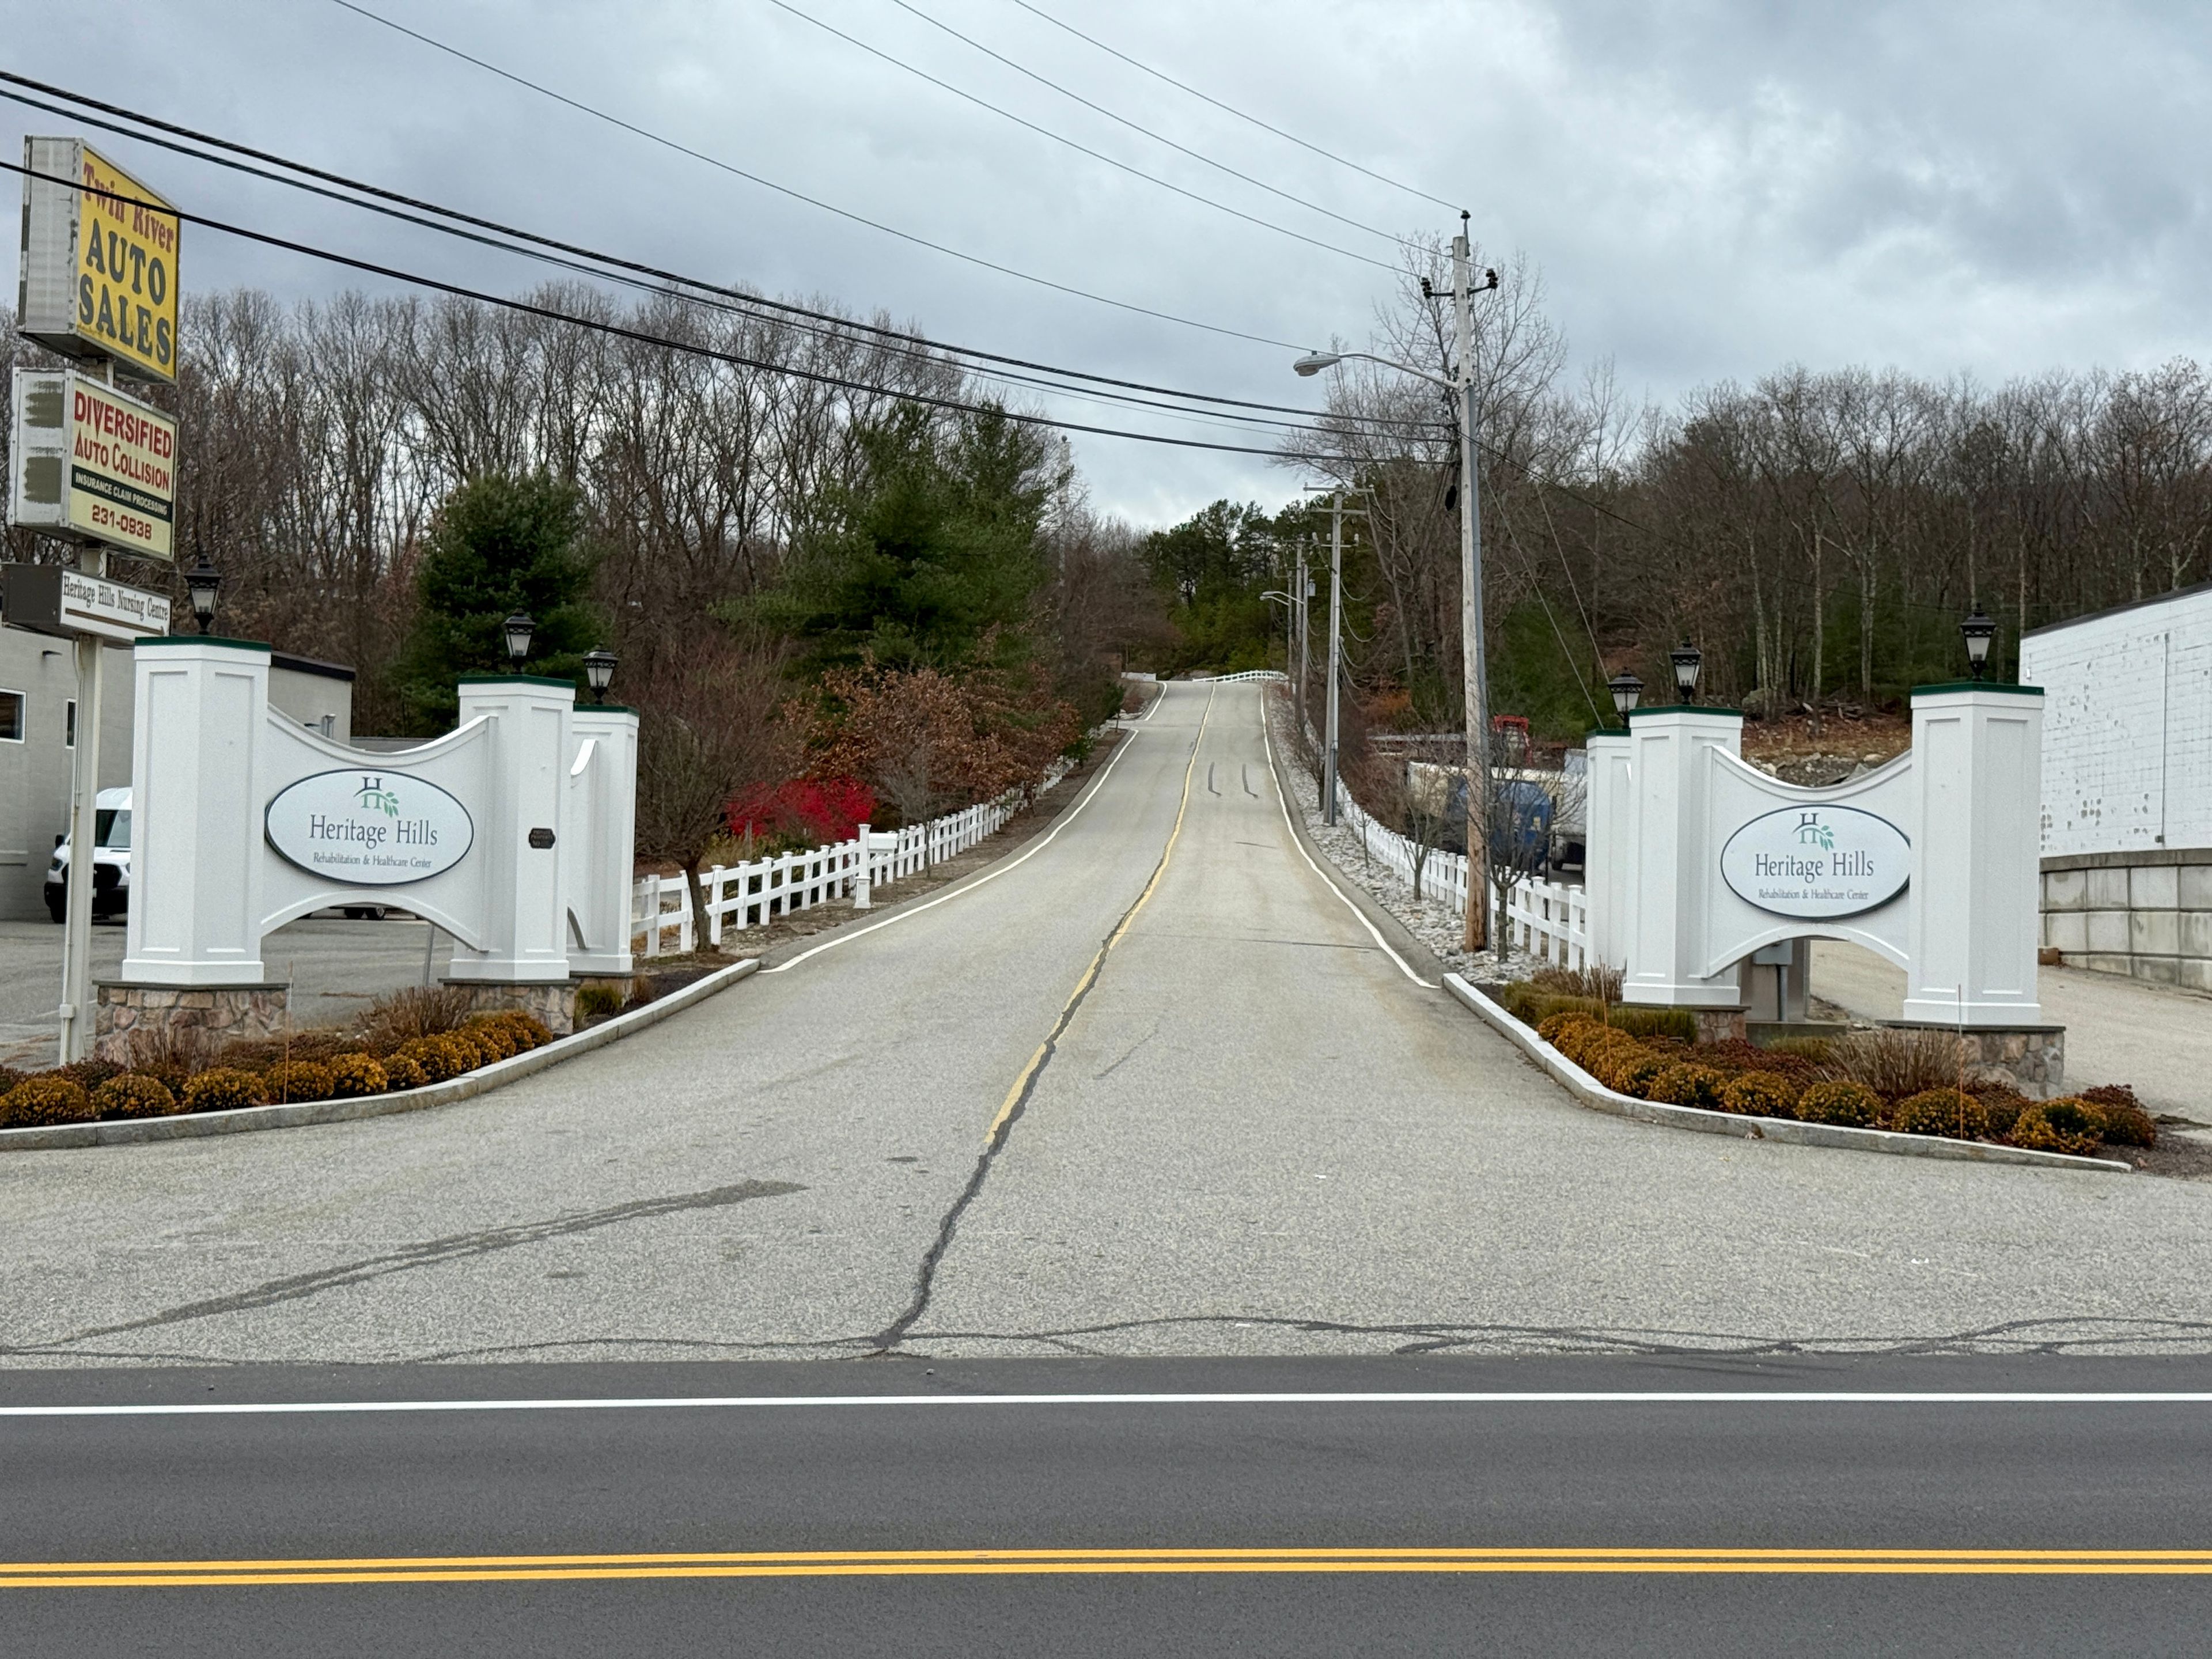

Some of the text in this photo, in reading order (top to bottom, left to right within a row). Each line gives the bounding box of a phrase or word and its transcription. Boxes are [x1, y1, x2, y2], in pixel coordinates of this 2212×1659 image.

[84, 161, 174, 253] Twin River
[86, 218, 166, 306] AUTO
[79, 273, 171, 365] SALES
[74, 391, 172, 459] DIVERSIFIED
[74, 427, 169, 493] AUTO COLLISION
[75, 472, 168, 516] INSURANCE CLAIM PROCESSING
[92, 505, 151, 540] 231-0938
[63, 575, 168, 621] Heritage Hills Nursing Centre
[309, 814, 438, 850] Heritage Hills
[313, 852, 432, 868] Rehabilitation & Healthcare Center
[1755, 850, 1874, 884] Heritage Hills
[1759, 888, 1869, 900] Rehabilitation & Healthcare Center
